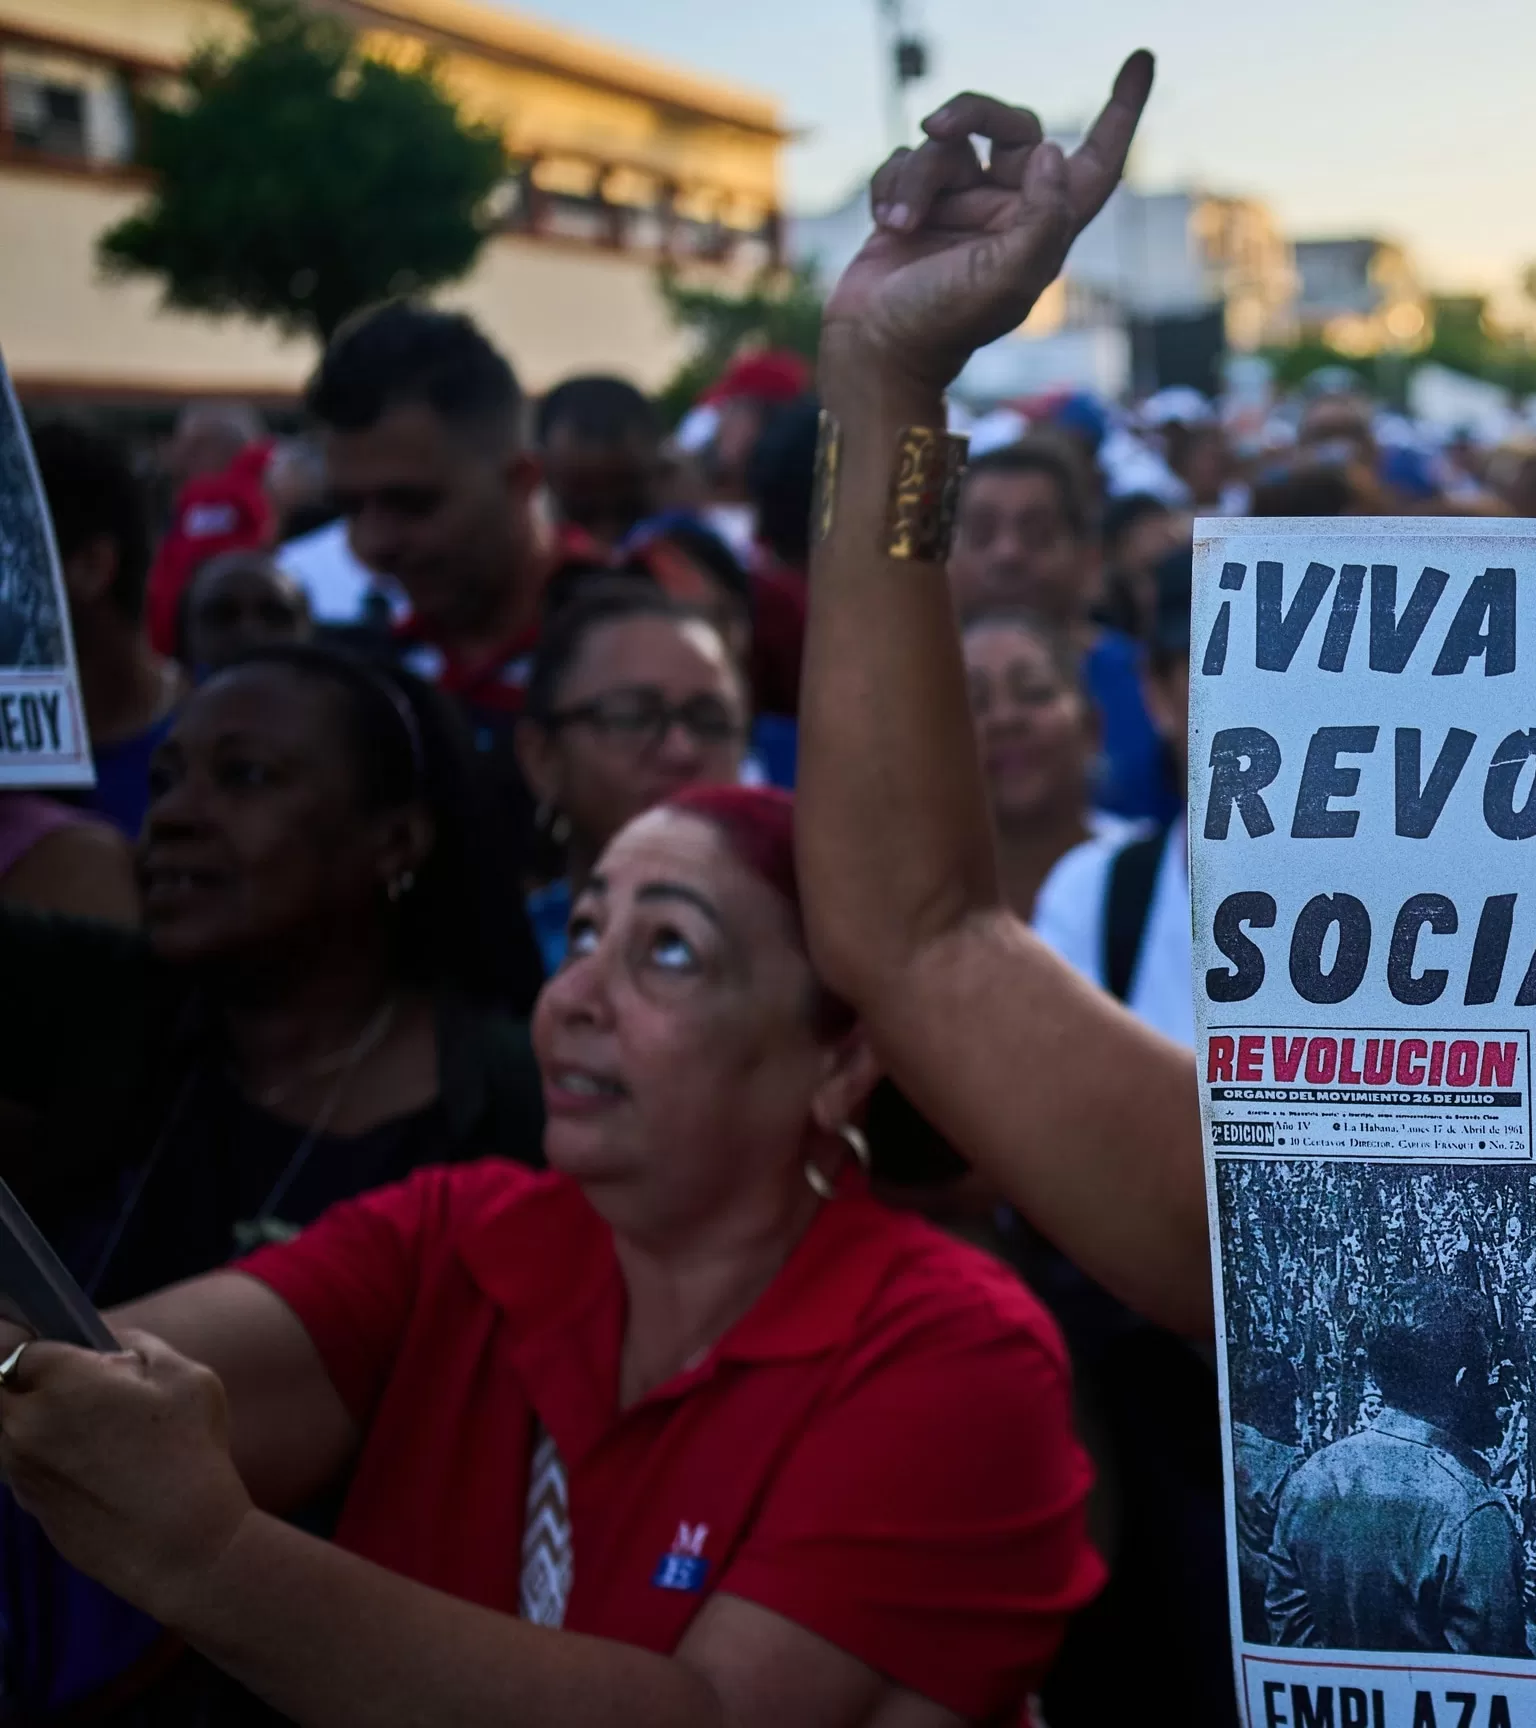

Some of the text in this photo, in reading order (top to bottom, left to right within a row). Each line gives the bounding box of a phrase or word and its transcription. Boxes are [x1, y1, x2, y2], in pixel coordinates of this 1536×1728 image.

[1202, 561, 1517, 677] ¡VIVA
[0, 690, 61, 751] EDY
[1207, 1035, 1518, 1088] REVOLUCION
[1222, 1089, 1495, 1105] ORGANO DEL MOVIMIENTO 26 DE JULIO
[1222, 1124, 1275, 1144] EDICION
[1298, 1121, 1311, 1131] IV
[1433, 1124, 1443, 1134] 17
[1447, 1124, 1457, 1134] de
[1461, 1124, 1486, 1135] Abril
[1489, 1124, 1500, 1135] de
[1504, 1124, 1523, 1135] 1961
[1290, 1137, 1300, 1147] 10
